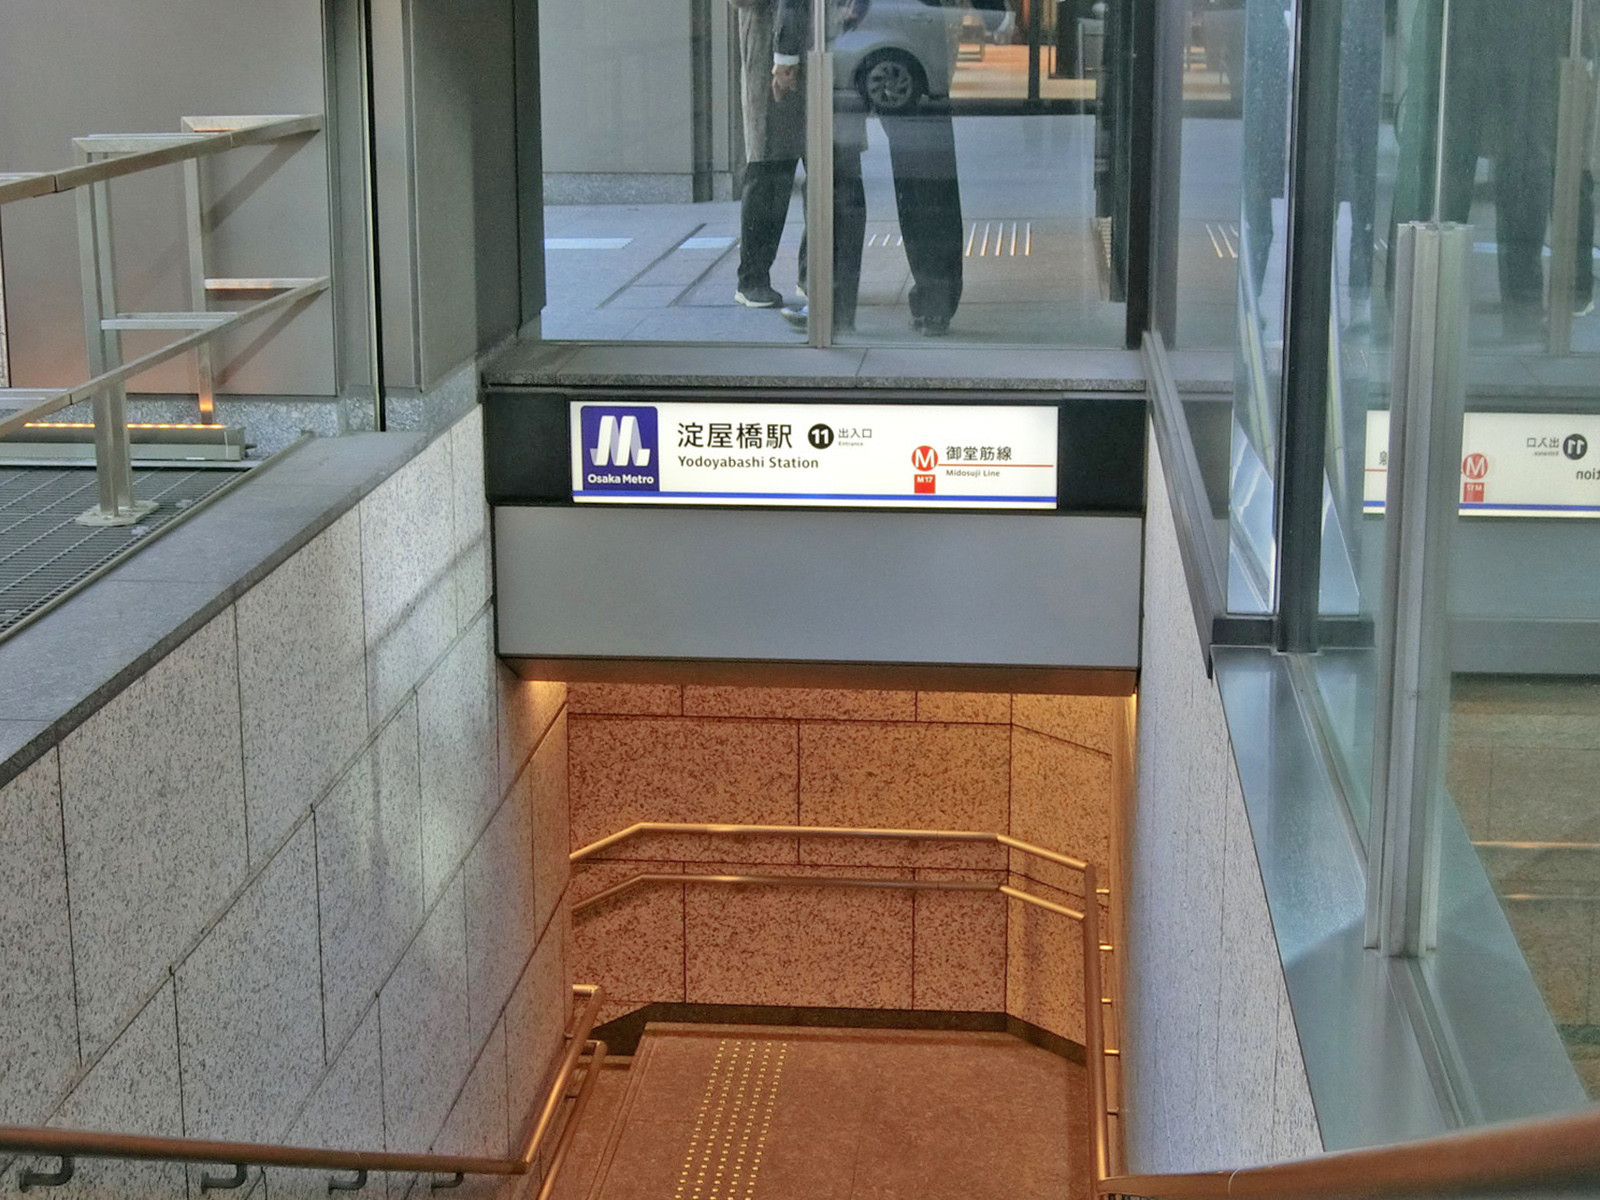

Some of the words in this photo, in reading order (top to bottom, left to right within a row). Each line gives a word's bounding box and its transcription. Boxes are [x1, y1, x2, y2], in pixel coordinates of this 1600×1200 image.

[677, 422, 793, 449] 淀屋橋駅
[811, 428, 830, 445] 11
[838, 428, 873, 439] 出入口
[915, 448, 937, 469] M
[946, 446, 1012, 461] 御堂筋線
[678, 456, 765, 470] Yodoyabashi
[769, 457, 819, 469] Station
[587, 473, 622, 484] Osaka
[622, 474, 655, 485] Metro
[946, 469, 981, 478] Midosuji
[983, 470, 1000, 478] Line
